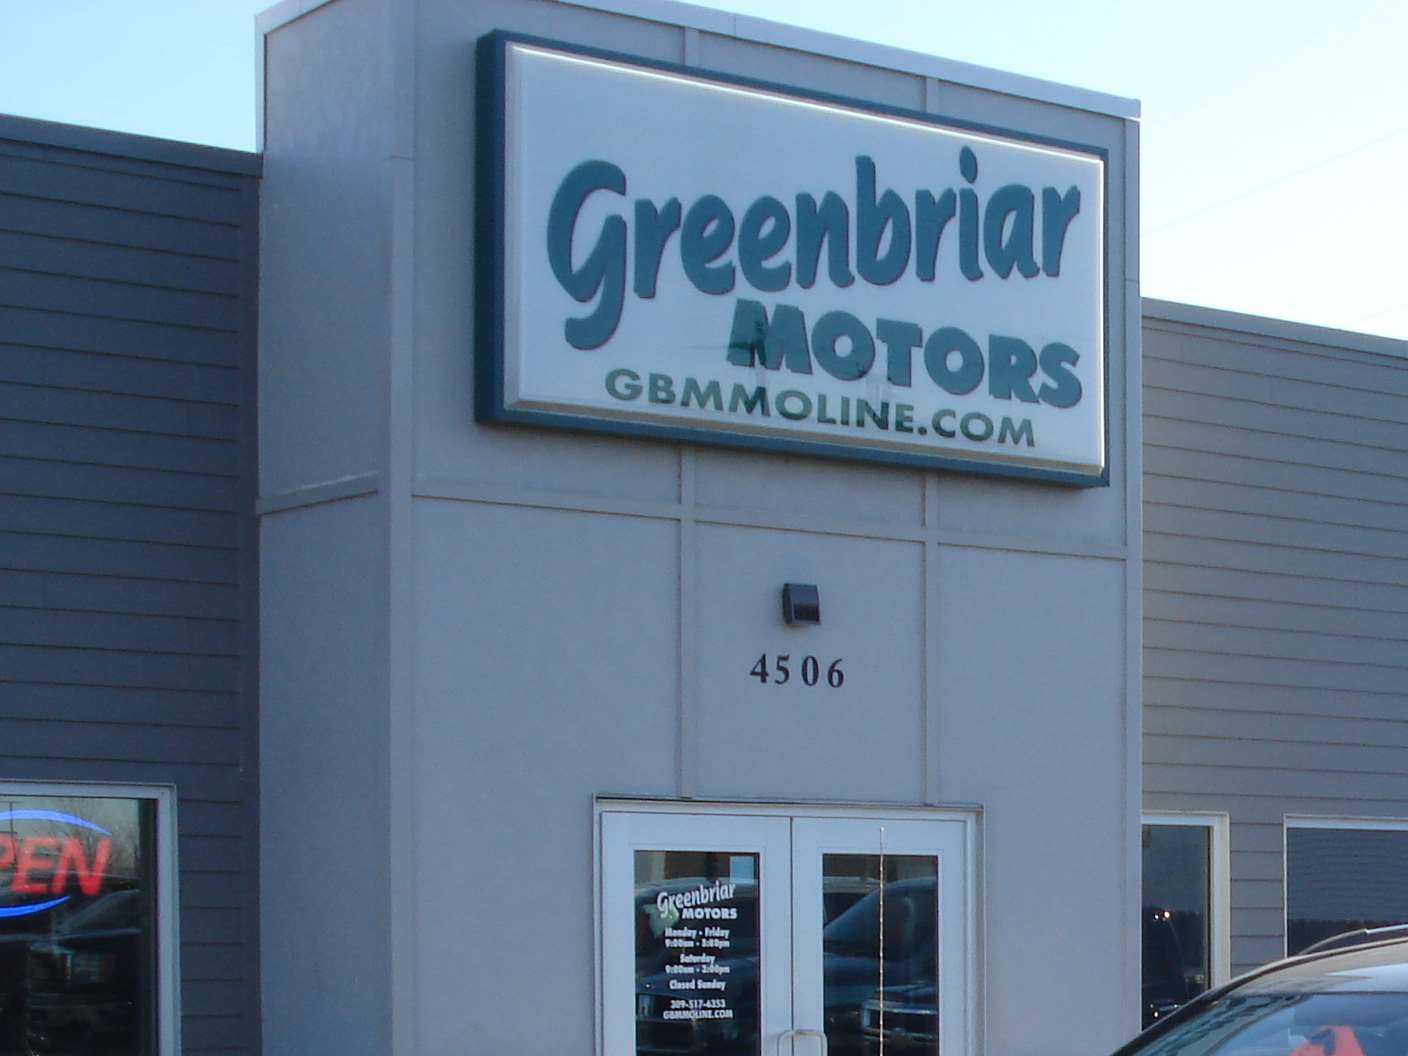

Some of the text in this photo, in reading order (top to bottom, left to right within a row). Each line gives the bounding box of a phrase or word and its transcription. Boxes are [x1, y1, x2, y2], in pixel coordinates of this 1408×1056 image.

[548, 146, 1081, 351] Greenbriar
[727, 299, 1083, 409] MOTORS
[604, 367, 1036, 448] GBMMOLINE.COM
[750, 652, 844, 688] 4506
[657, 880, 736, 919] Greenbriar
[682, 908, 738, 919] MOTORS
[665, 926, 697, 939] Monday
[704, 926, 730, 939] Friday
[680, 953, 716, 964] Saturday
[669, 979, 726, 991] Closed Sunday
